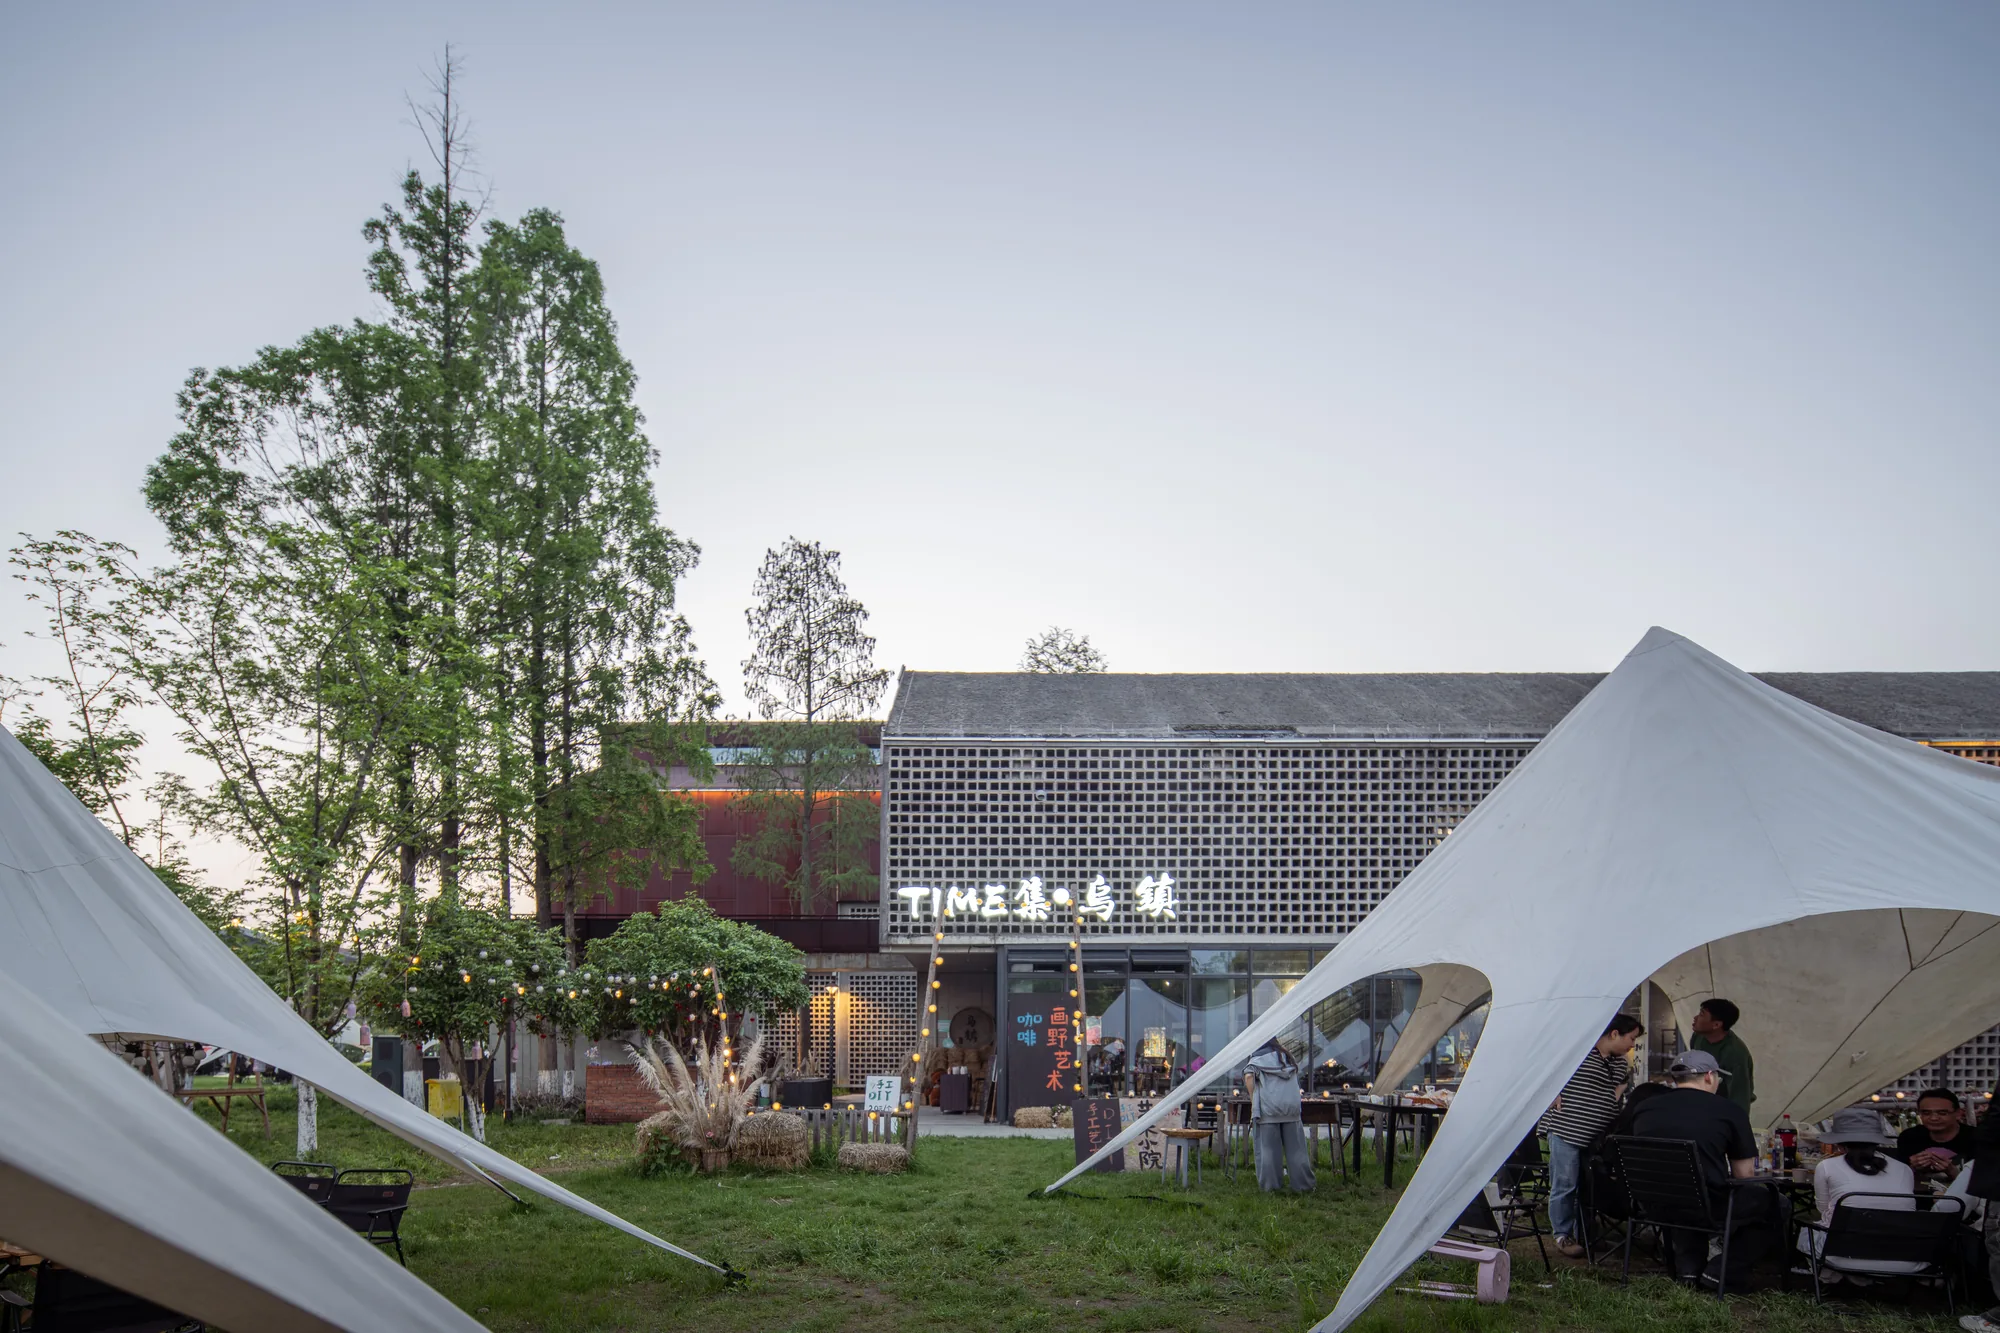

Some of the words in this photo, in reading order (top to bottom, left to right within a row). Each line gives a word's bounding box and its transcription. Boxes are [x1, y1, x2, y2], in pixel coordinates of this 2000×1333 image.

[1017, 1012, 1043, 1047] 咖啡
[1046, 1007, 1072, 1091] 画野艺术
[868, 1090, 892, 1101] DIY
